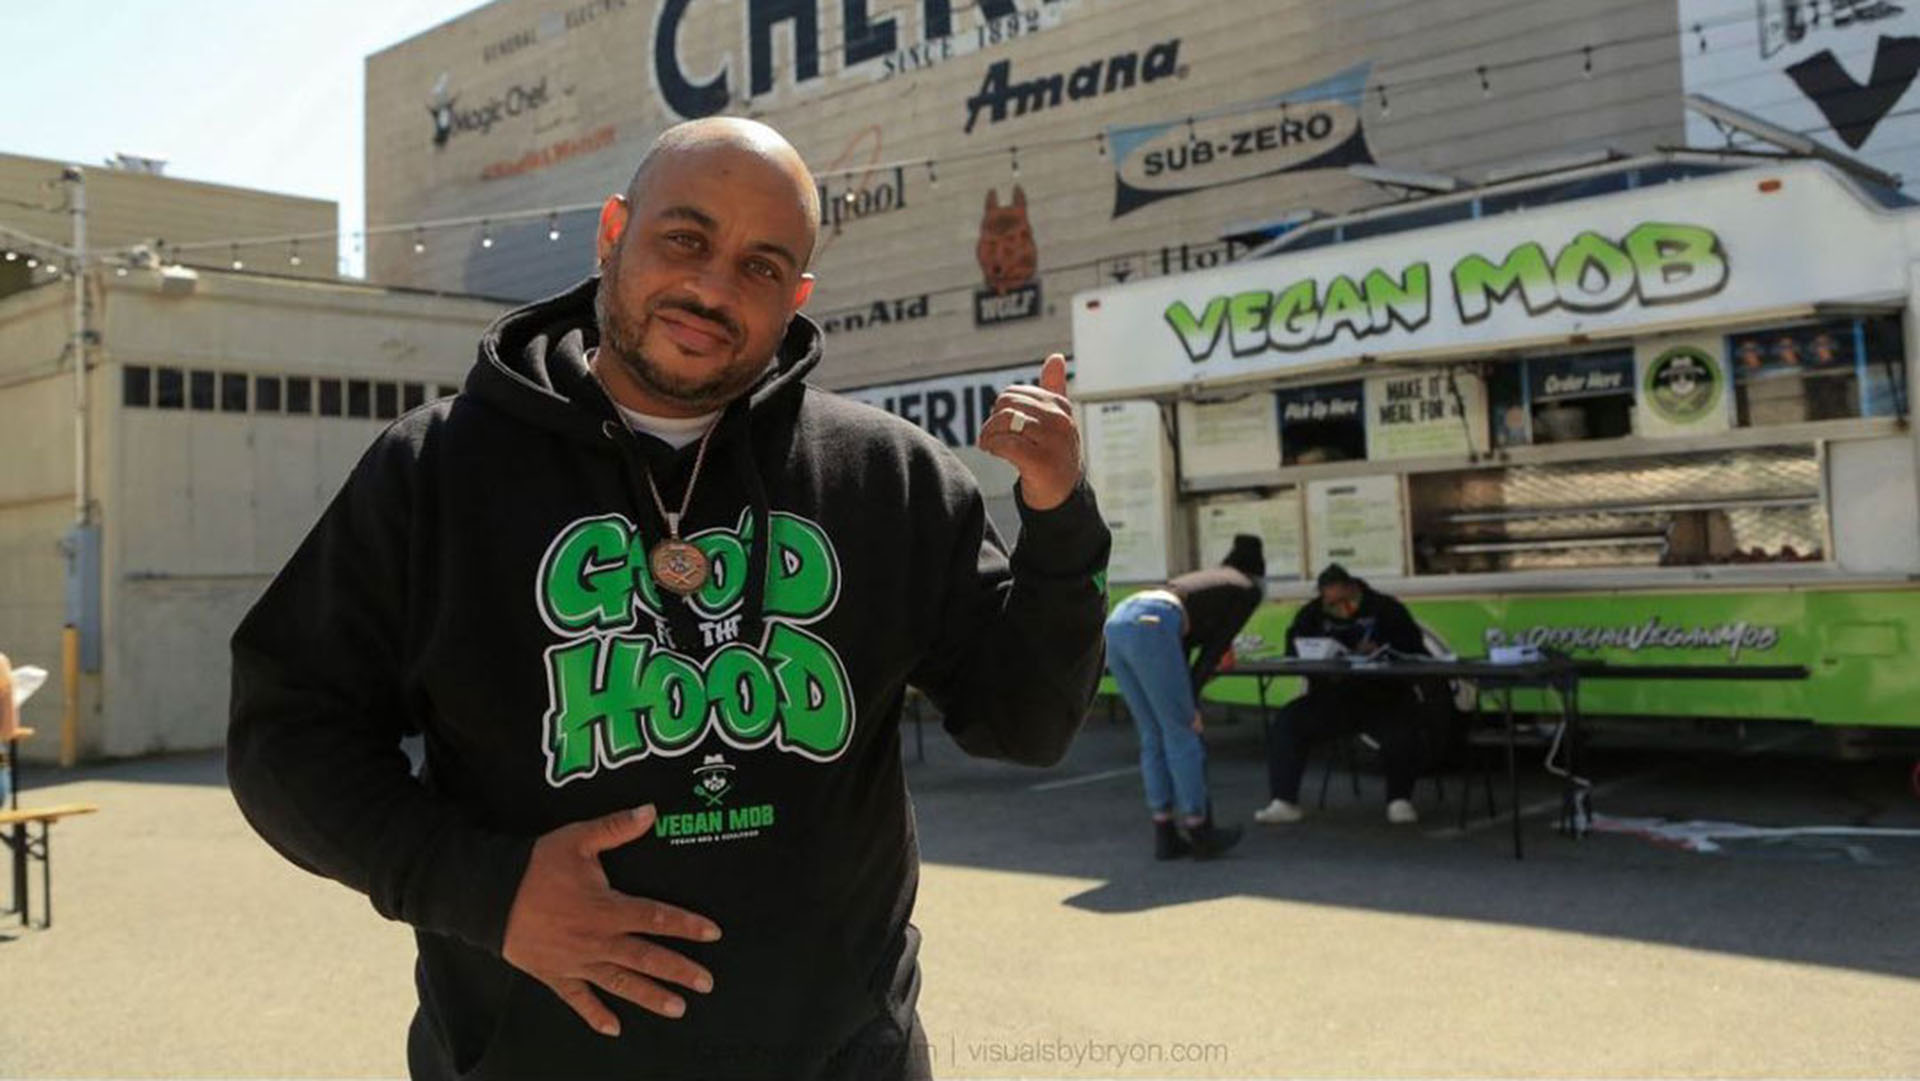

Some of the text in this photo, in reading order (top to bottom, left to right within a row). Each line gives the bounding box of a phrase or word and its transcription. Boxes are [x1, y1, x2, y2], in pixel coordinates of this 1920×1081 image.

[882, 10, 1040, 79] SINCE 1892
[963, 37, 1181, 134] Amana
[1143, 112, 1334, 177] SUB-ZERO
[820, 166, 907, 236] lpool
[824, 294, 929, 334] enAid
[1164, 220, 1729, 364] VEGAN MOB
[541, 620, 856, 788] HOOD
[655, 804, 775, 838] VEGAN MOB
